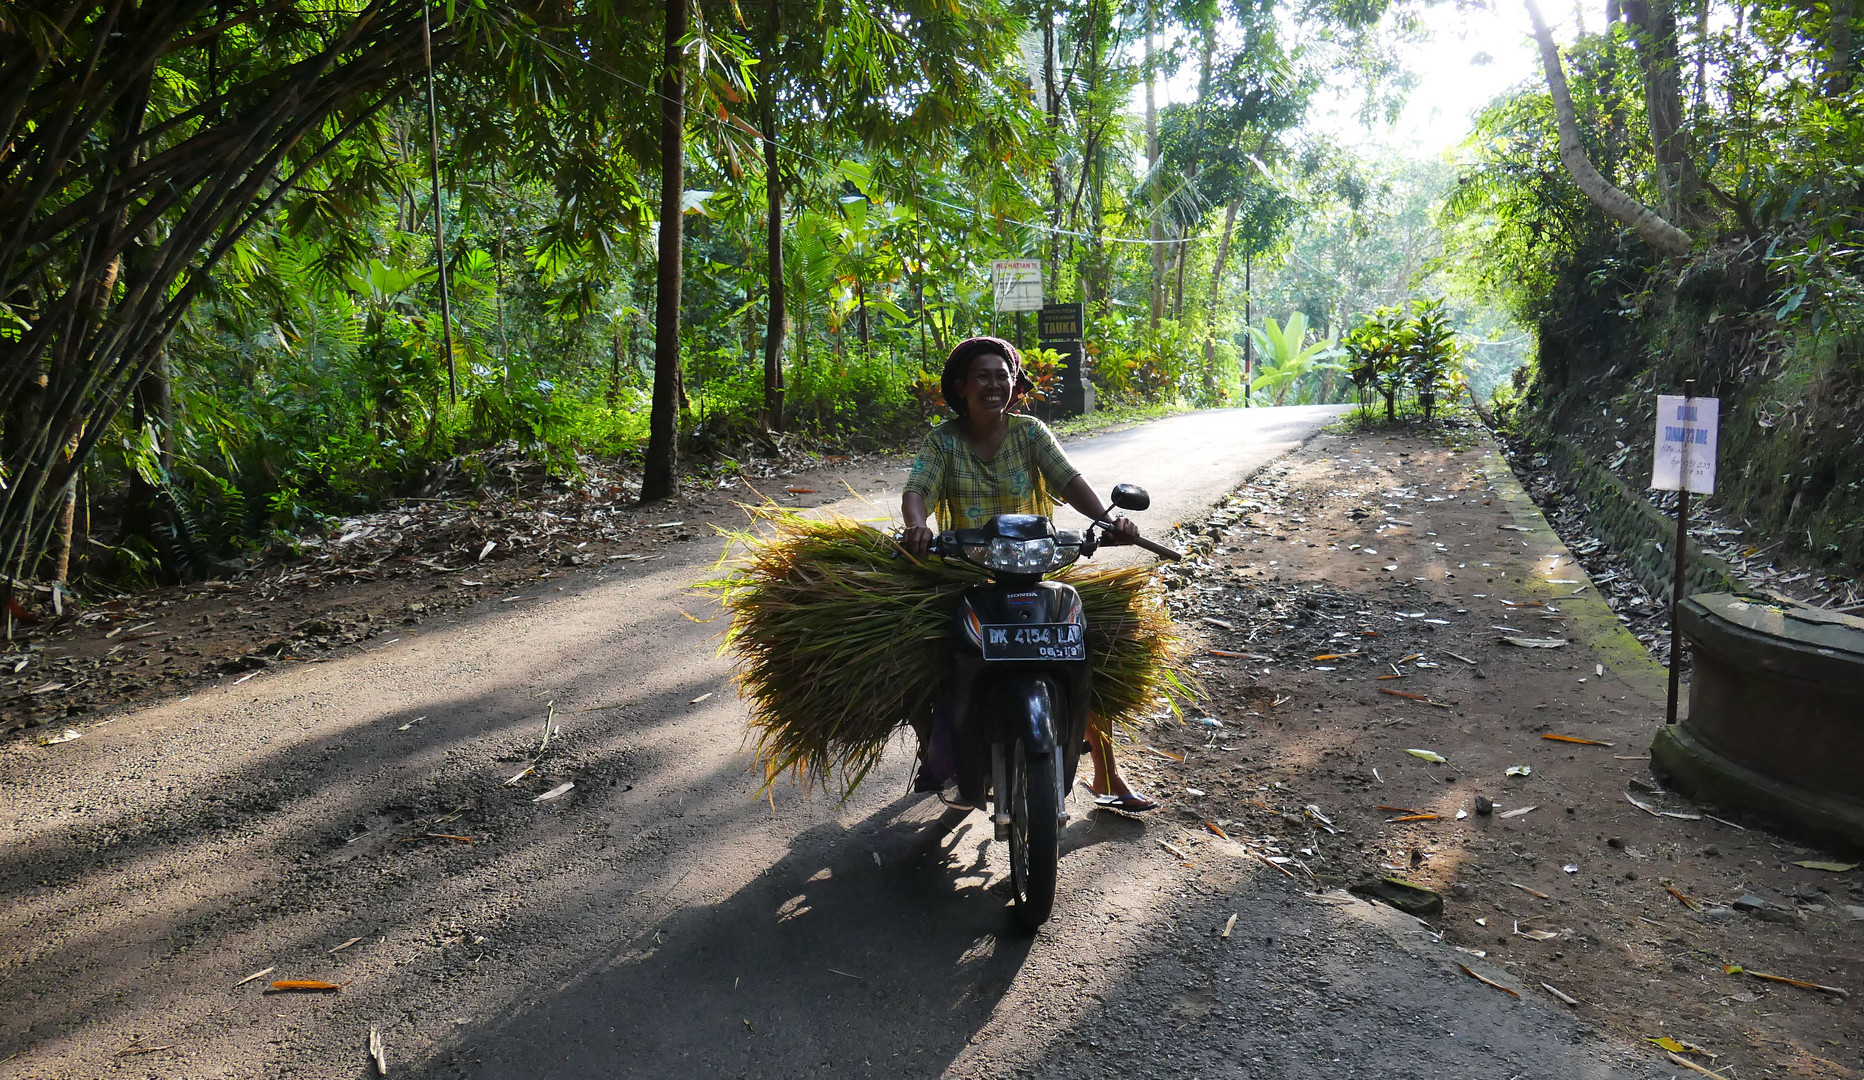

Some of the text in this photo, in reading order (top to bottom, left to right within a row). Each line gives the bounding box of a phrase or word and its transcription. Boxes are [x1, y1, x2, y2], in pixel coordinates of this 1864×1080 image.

[1043, 321, 1077, 334] TAUKA
[1685, 427, 1695, 443] 23
[989, 628, 1008, 644] DK
[1015, 628, 1051, 644] 4154
